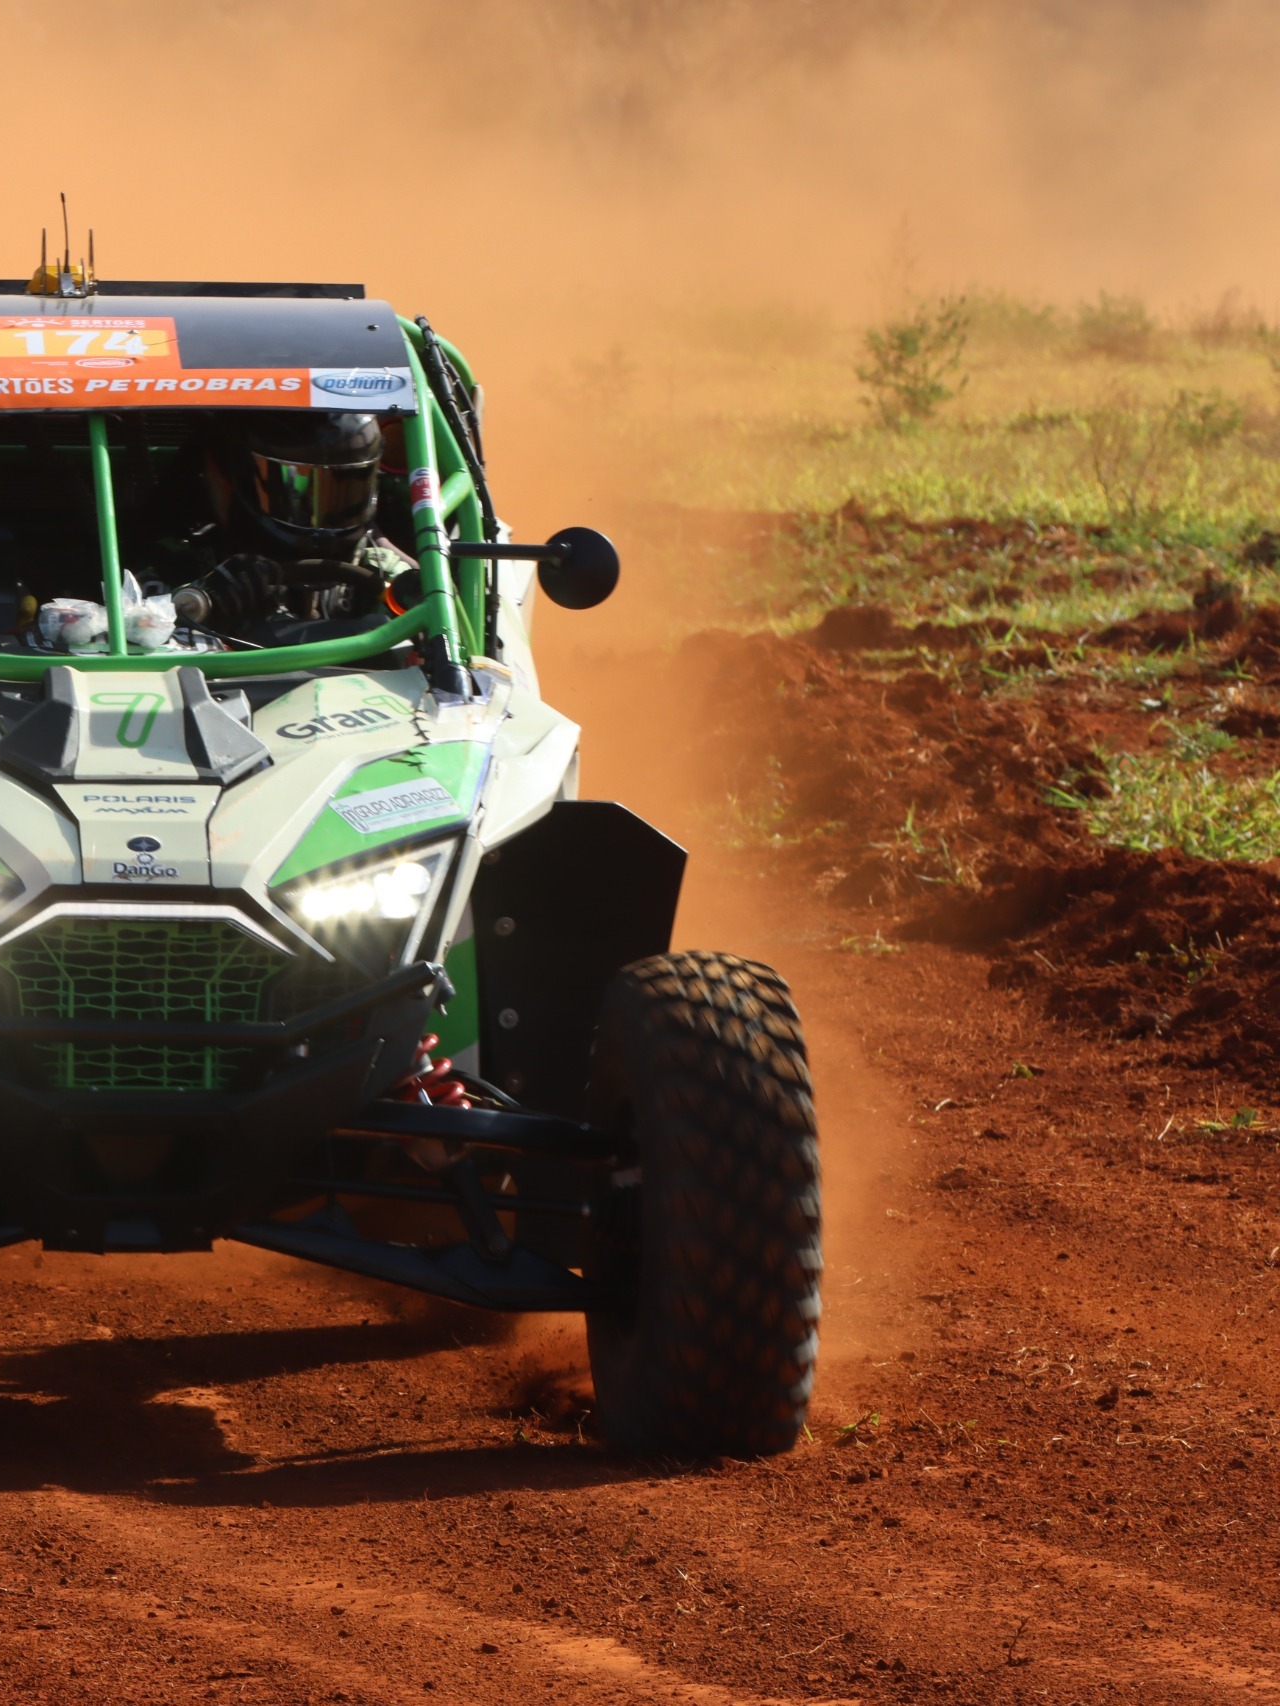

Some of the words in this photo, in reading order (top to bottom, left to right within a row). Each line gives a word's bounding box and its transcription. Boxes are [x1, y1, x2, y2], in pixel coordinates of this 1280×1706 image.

[13, 330, 148, 355] 174
[84, 377, 302, 392] PETROBRAS
[324, 376, 393, 391] podium
[276, 708, 391, 739] Gran
[83, 795, 197, 804] POLARIS
[353, 798, 393, 819] GRUPO
[113, 862, 177, 876] DanGo
